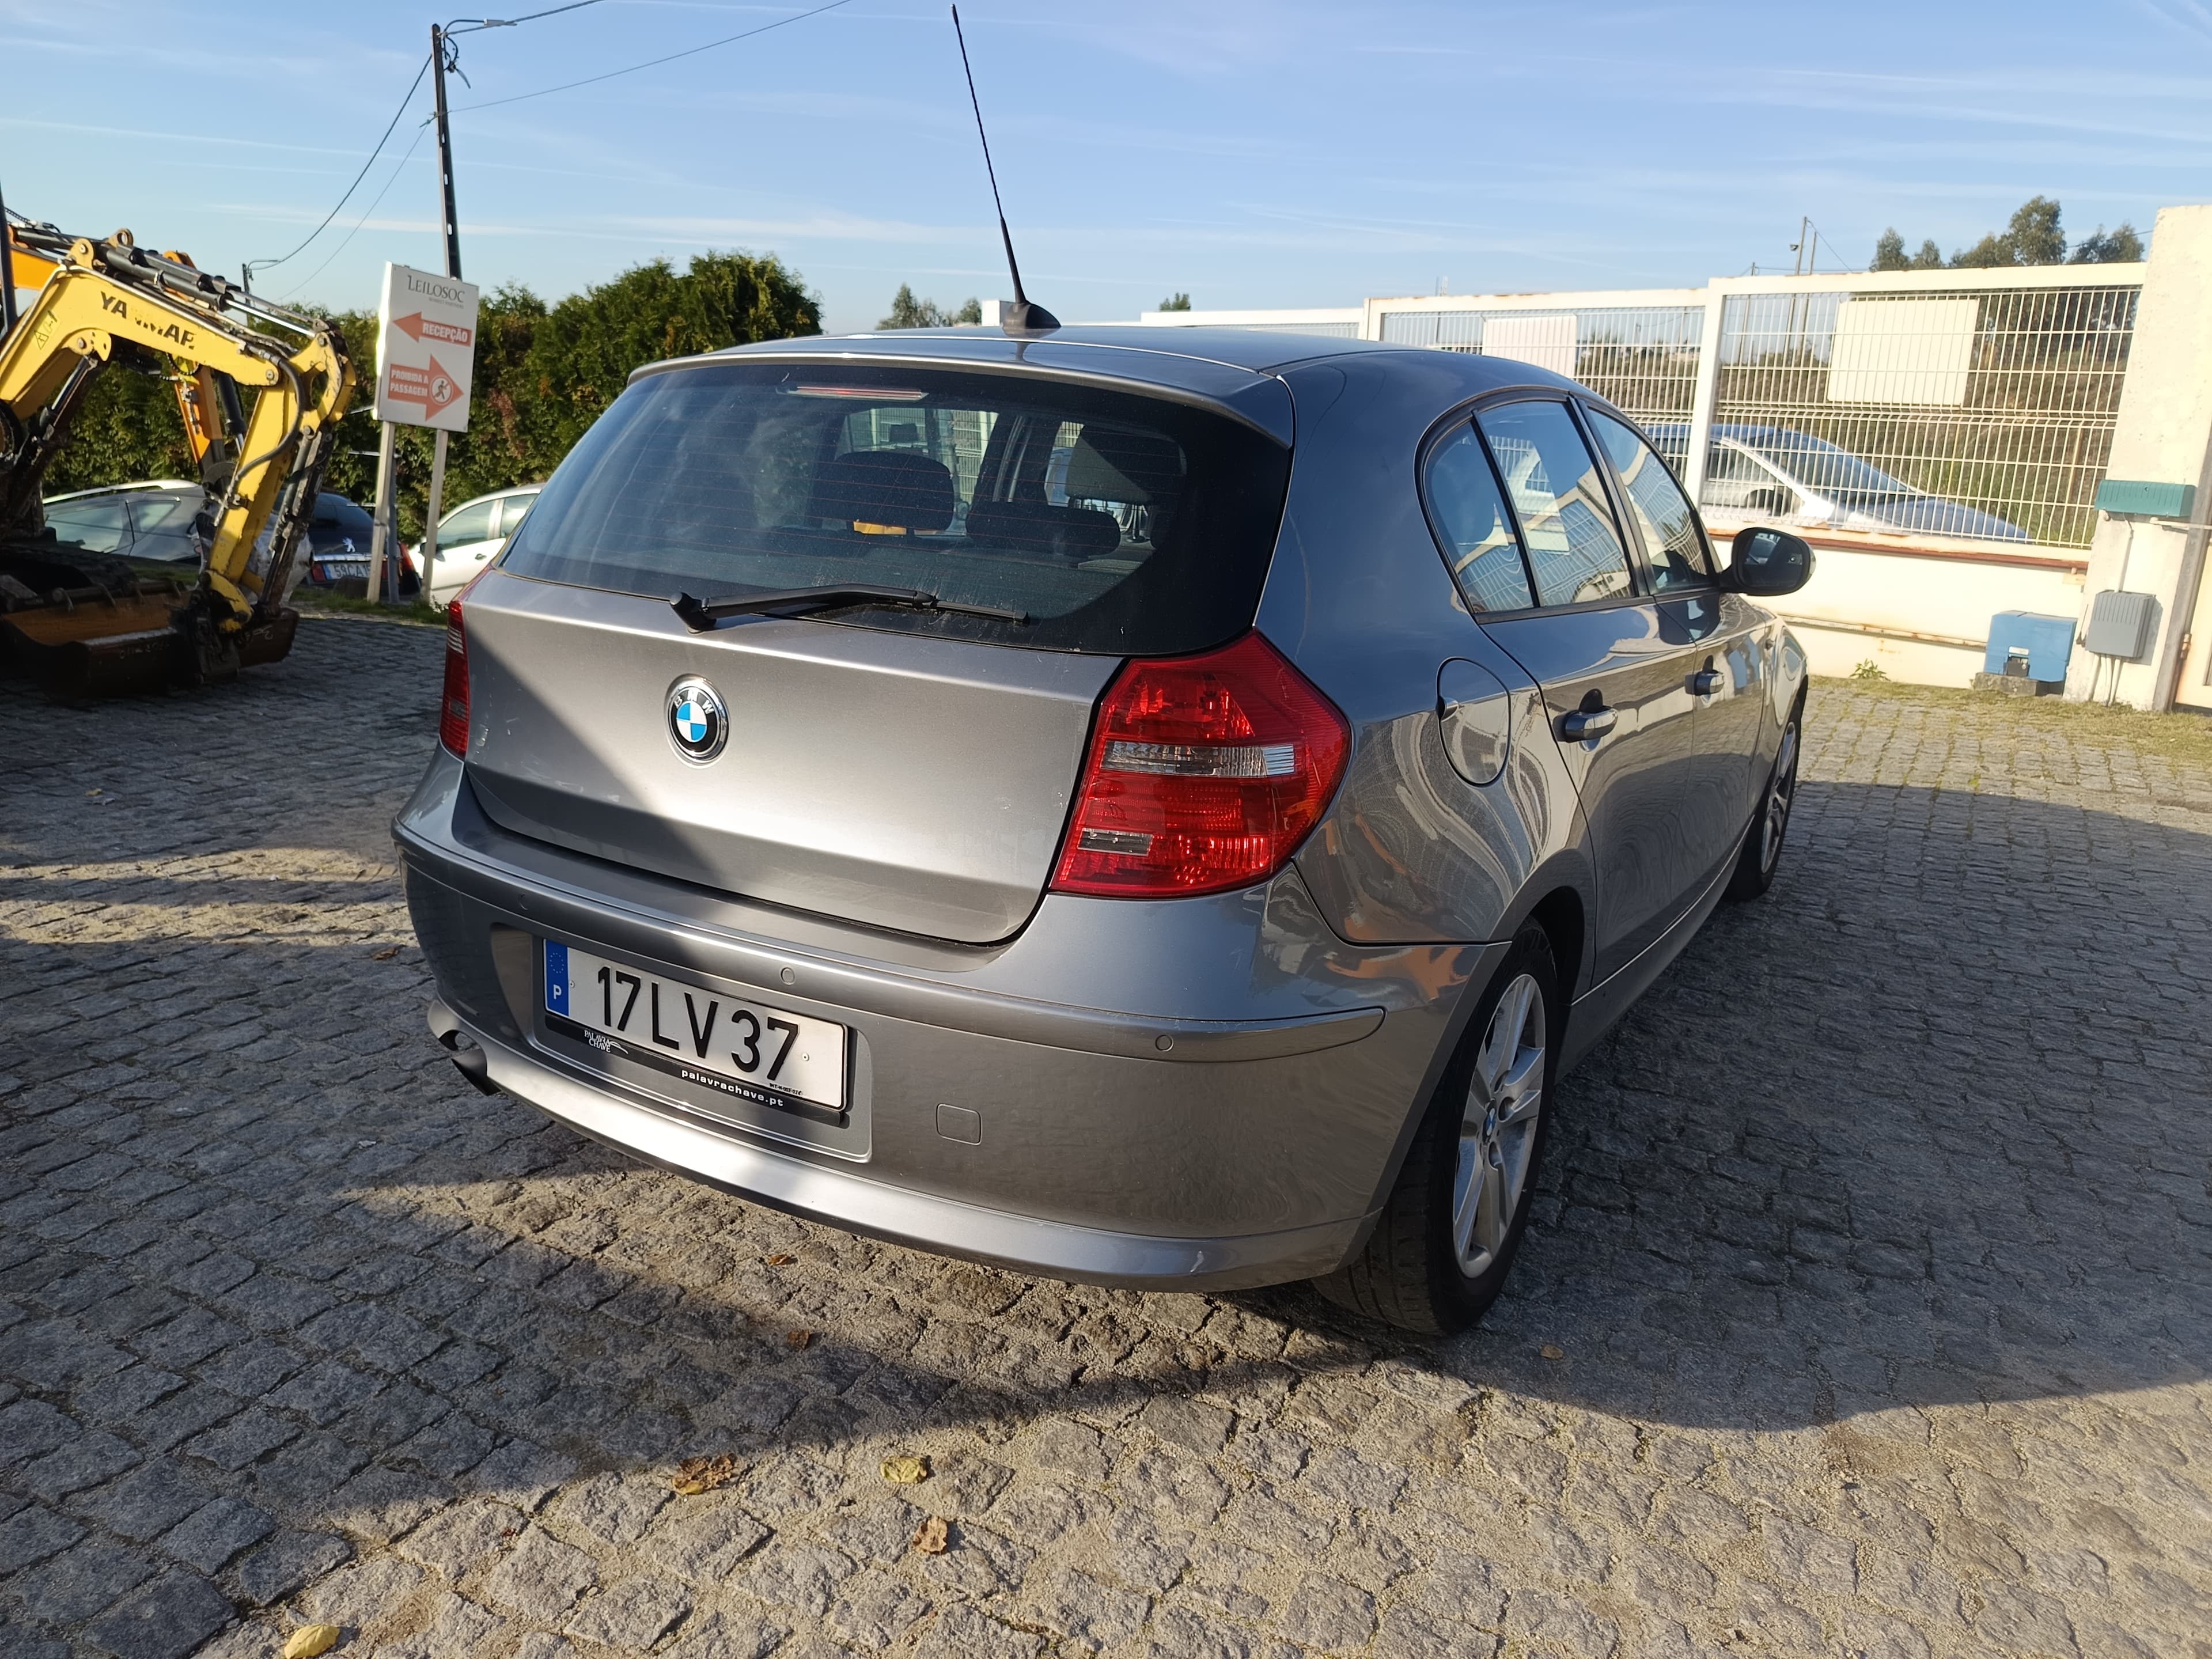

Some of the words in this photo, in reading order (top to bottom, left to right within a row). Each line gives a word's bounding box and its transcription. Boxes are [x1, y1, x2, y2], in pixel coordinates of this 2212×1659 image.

[408, 275, 465, 303] LEILOSOC
[101, 291, 195, 350] YAAR
[423, 322, 468, 342] RECEPÇÃO
[392, 369, 423, 383] PROIBIDA
[423, 375, 429, 384] A
[390, 382, 428, 397] PASSAGEM
[674, 690, 714, 714] BMW
[553, 984, 562, 999] P
[584, 1029, 611, 1047] PALAVRA
[589, 1039, 611, 1053] CHAVE
[681, 1070, 783, 1107] palavrachave.pt
